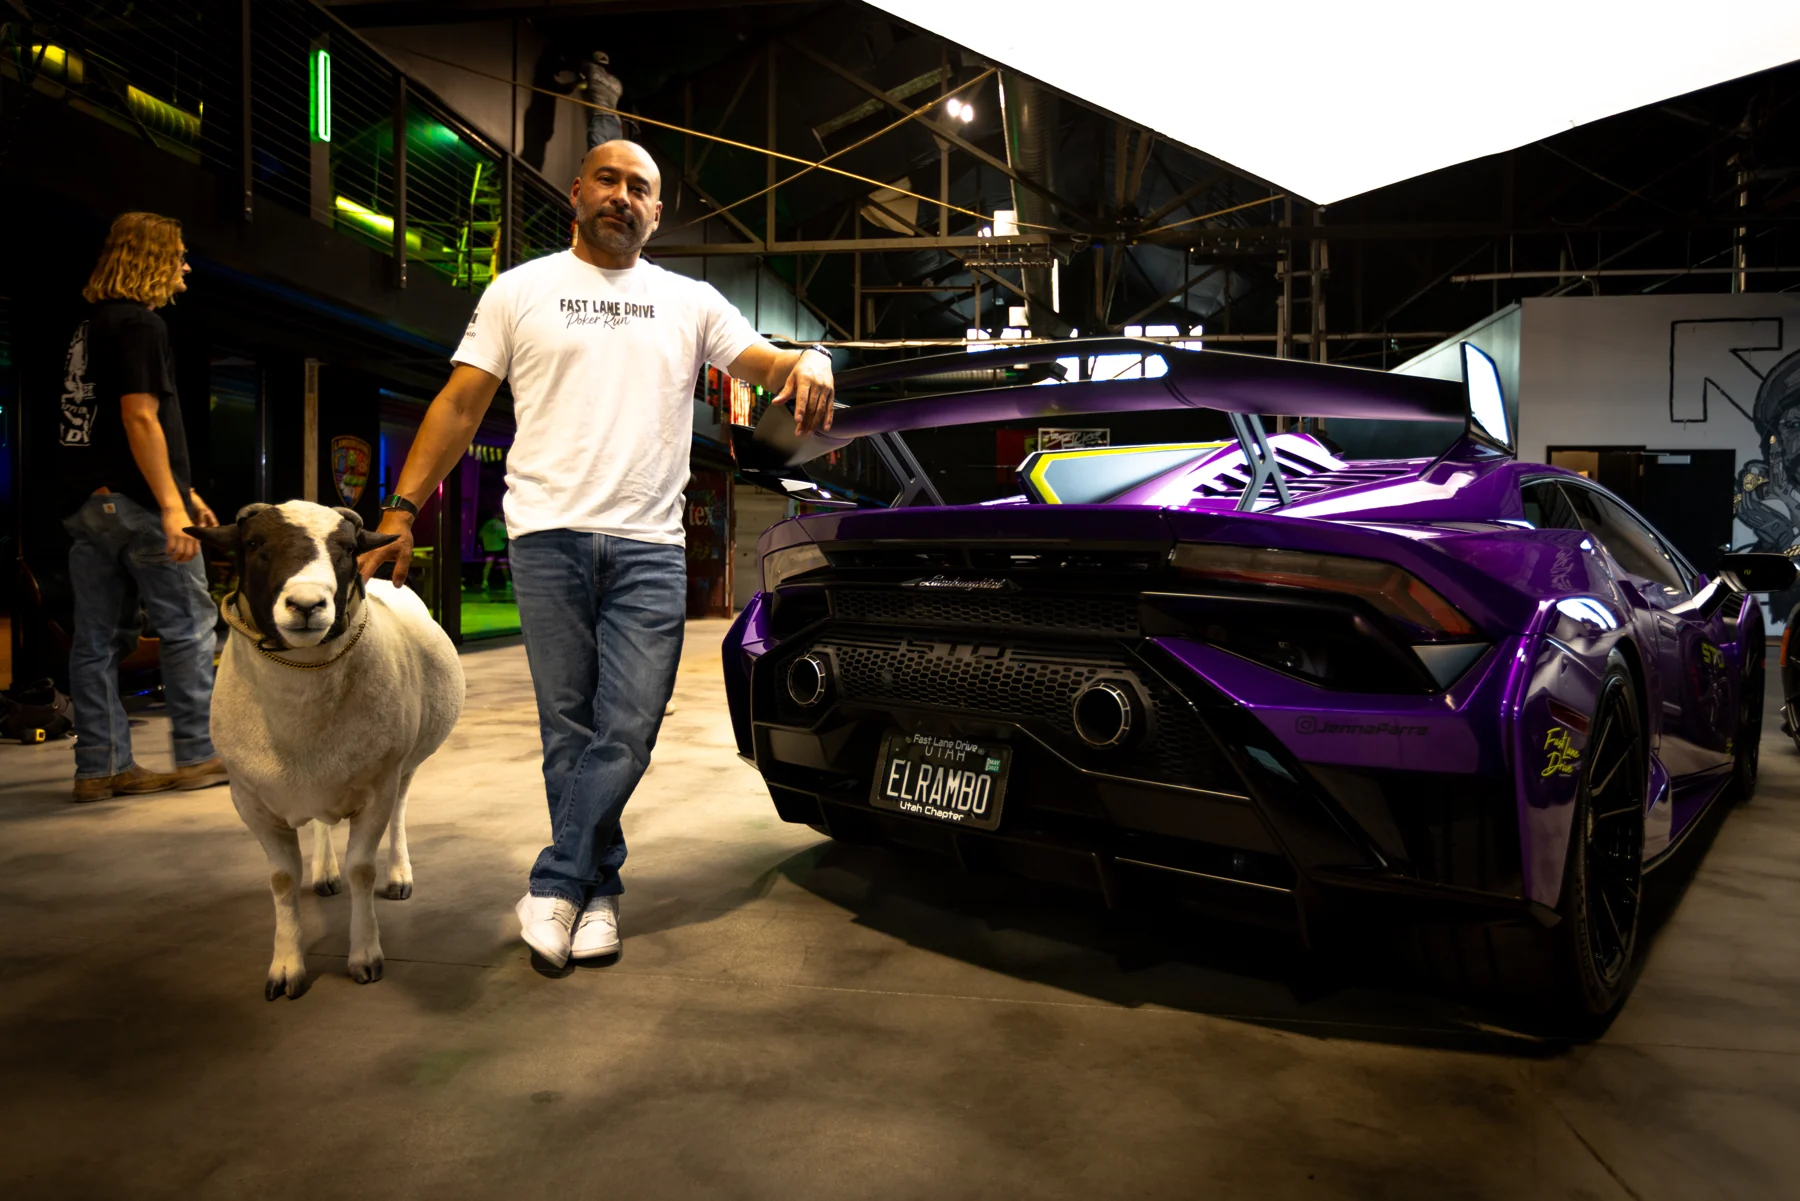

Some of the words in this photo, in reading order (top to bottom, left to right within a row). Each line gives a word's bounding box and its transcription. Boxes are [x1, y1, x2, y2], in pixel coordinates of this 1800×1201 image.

[560, 299, 588, 313] FAST
[593, 300, 620, 317] LANE
[624, 302, 655, 319] DRIVE
[565, 311, 601, 329] Poker
[602, 310, 631, 330] Run
[913, 733, 933, 745] Fast
[933, 737, 954, 748] Lane
[955, 740, 979, 753] Drive
[1543, 727, 1568, 750] Fast
[925, 746, 966, 762] UTAH
[886, 759, 992, 814] ELRAMBO
[900, 801, 923, 813] Utah
[924, 806, 965, 821] Chapter
